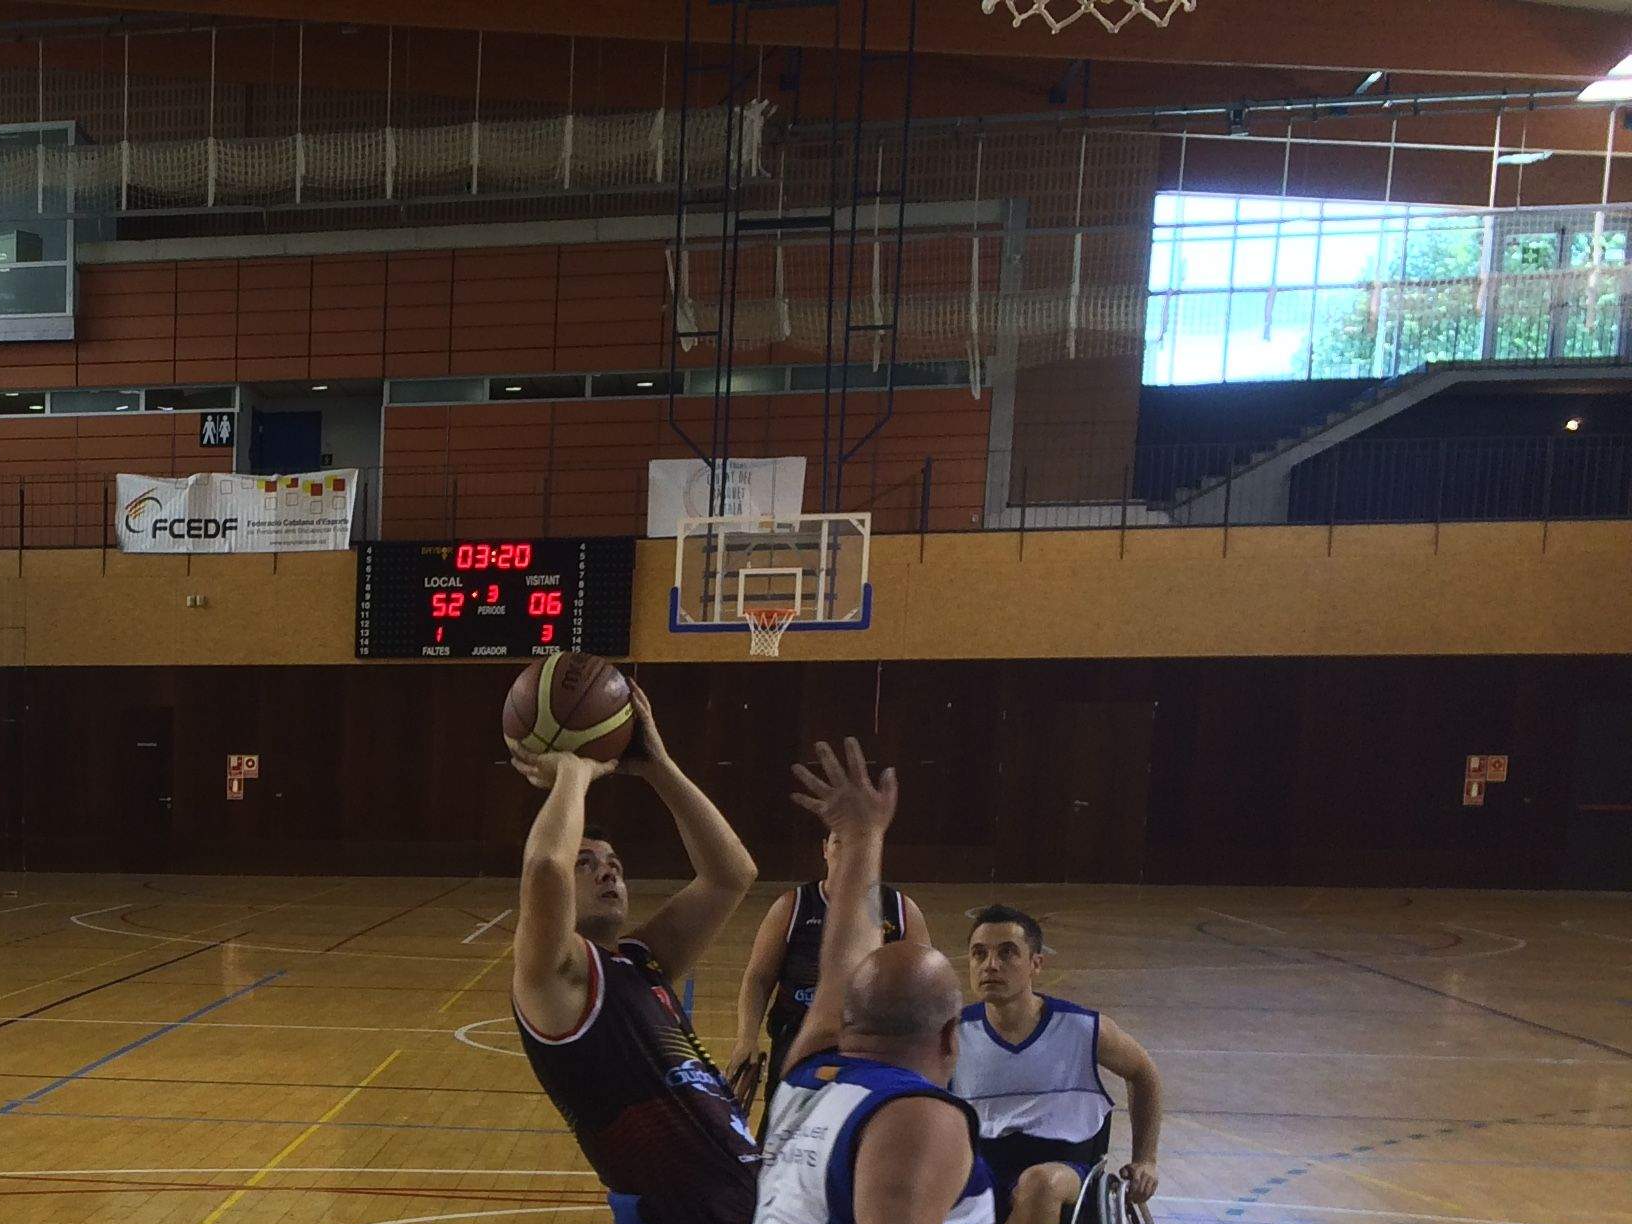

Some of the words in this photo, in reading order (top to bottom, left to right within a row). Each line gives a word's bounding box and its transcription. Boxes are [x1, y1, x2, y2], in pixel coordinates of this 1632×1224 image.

[152, 518, 238, 539] FCEDF
[456, 544, 531, 569] 03:20
[424, 577, 463, 588] LOCAL
[525, 575, 560, 586] VISITANT
[486, 584, 499, 602] 3
[432, 592, 465, 617] 52
[477, 605, 506, 615] PERIODE
[529, 592, 562, 615] 06
[541, 624, 553, 642] 3
[422, 646, 450, 656] FALTES
[471, 646, 507, 655] JUGADOR
[531, 645, 560, 655] FALTES
